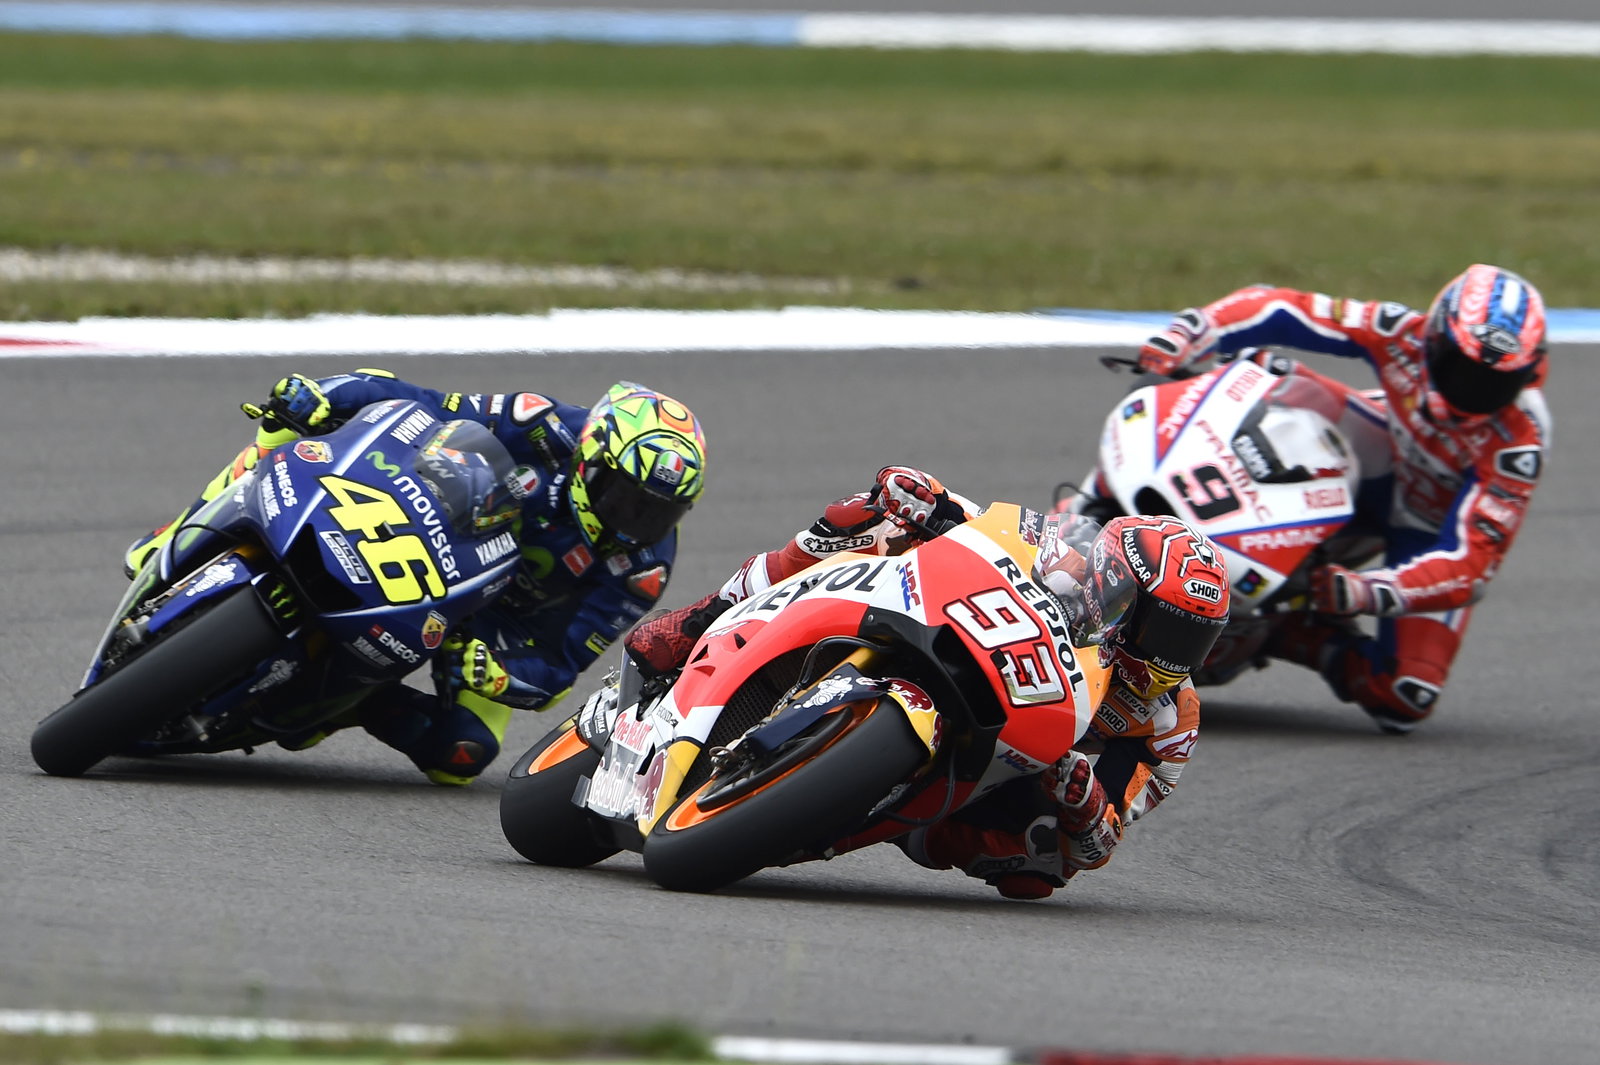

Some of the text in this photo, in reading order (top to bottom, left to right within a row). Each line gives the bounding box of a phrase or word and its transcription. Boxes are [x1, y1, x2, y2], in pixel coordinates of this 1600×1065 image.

[390, 409, 435, 445] YAMAHA
[274, 461, 298, 507] ENEOS
[1170, 463, 1241, 521] 9
[318, 474, 446, 604] 46
[393, 476, 462, 580] movistar
[803, 534, 874, 553] alpinestars
[475, 531, 518, 566] YAMAHA
[1123, 529, 1151, 583] PULL&BEAR
[899, 562, 921, 611] HRC
[1190, 582, 1220, 601] SHOEI
[994, 557, 1084, 692] REPSOL
[1046, 591, 1070, 628] HONDA
[1159, 601, 1185, 616] GIVES
[378, 631, 420, 663] ENEOS
[942, 588, 1068, 708] 93
[1153, 656, 1191, 672] PULL&BEAR
[1100, 706, 1125, 731] SHOEI
[1118, 690, 1150, 717] REPSOL
